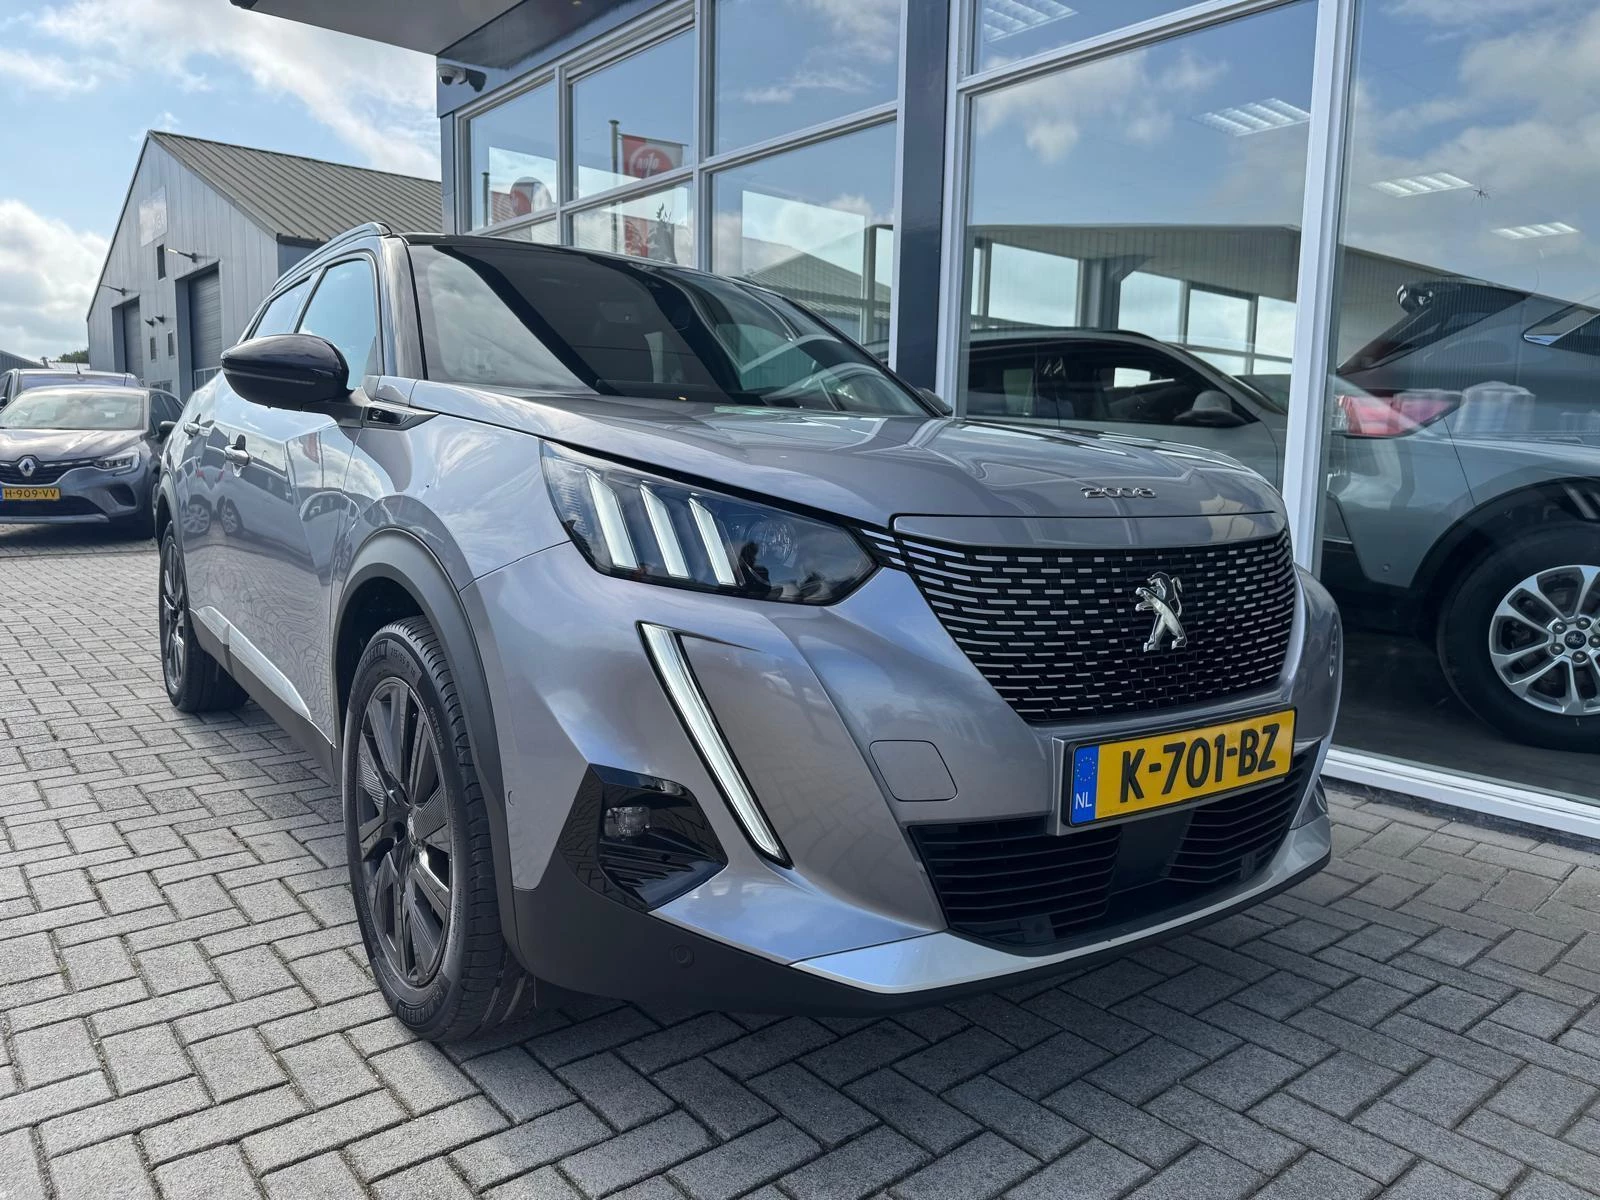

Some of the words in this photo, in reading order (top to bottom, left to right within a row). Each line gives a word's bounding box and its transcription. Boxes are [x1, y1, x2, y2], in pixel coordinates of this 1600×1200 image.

[4, 489, 57, 499] H-909-VV
[1119, 723, 1281, 804] K-701-BZ
[1075, 793, 1093, 810] NL
